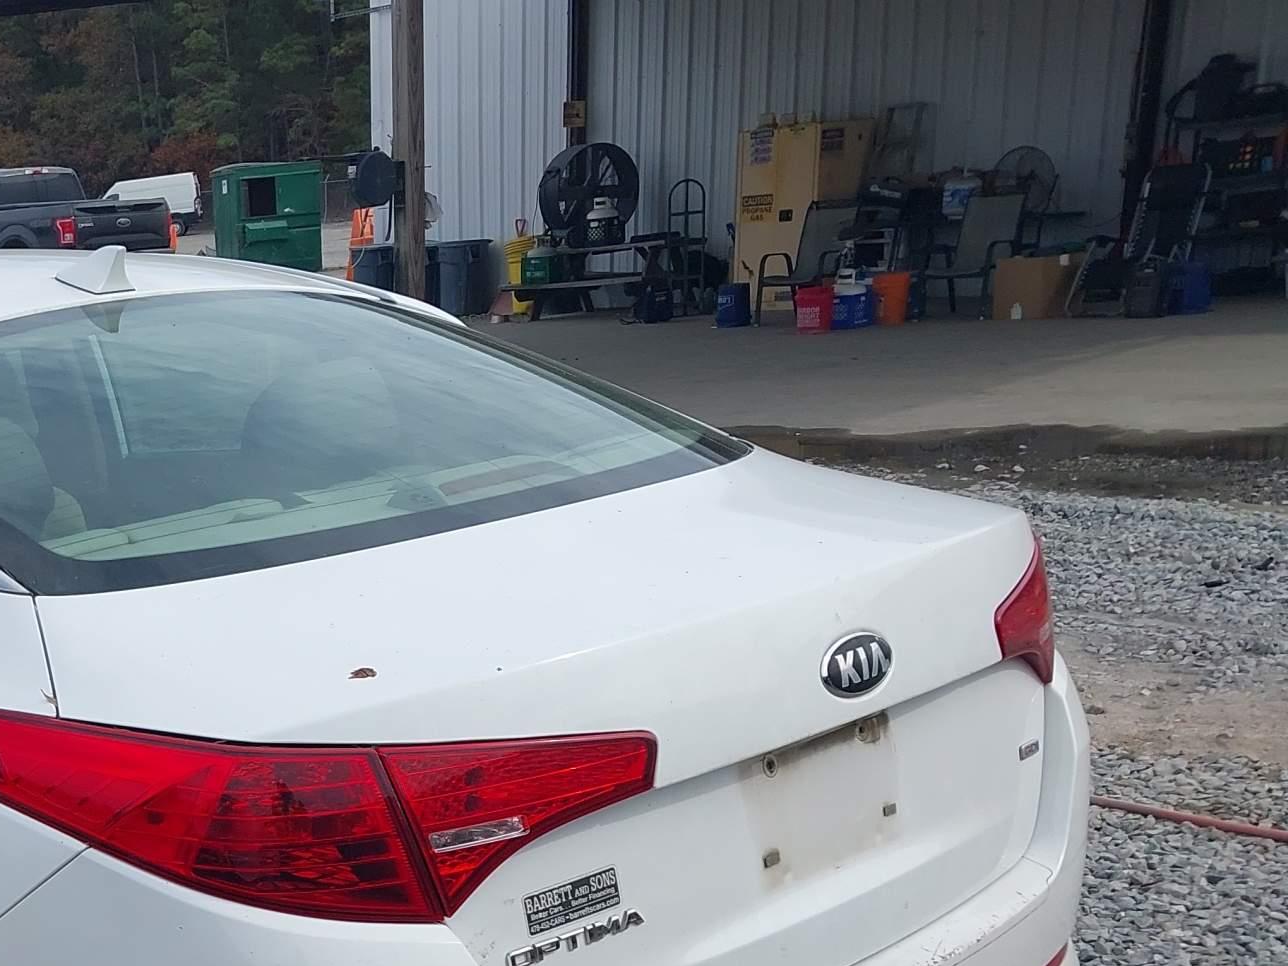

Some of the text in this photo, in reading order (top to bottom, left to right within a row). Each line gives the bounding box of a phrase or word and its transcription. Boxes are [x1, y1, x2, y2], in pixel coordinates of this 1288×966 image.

[834, 641, 890, 688] KIA
[525, 870, 616, 914] BARRETT AND SONS
